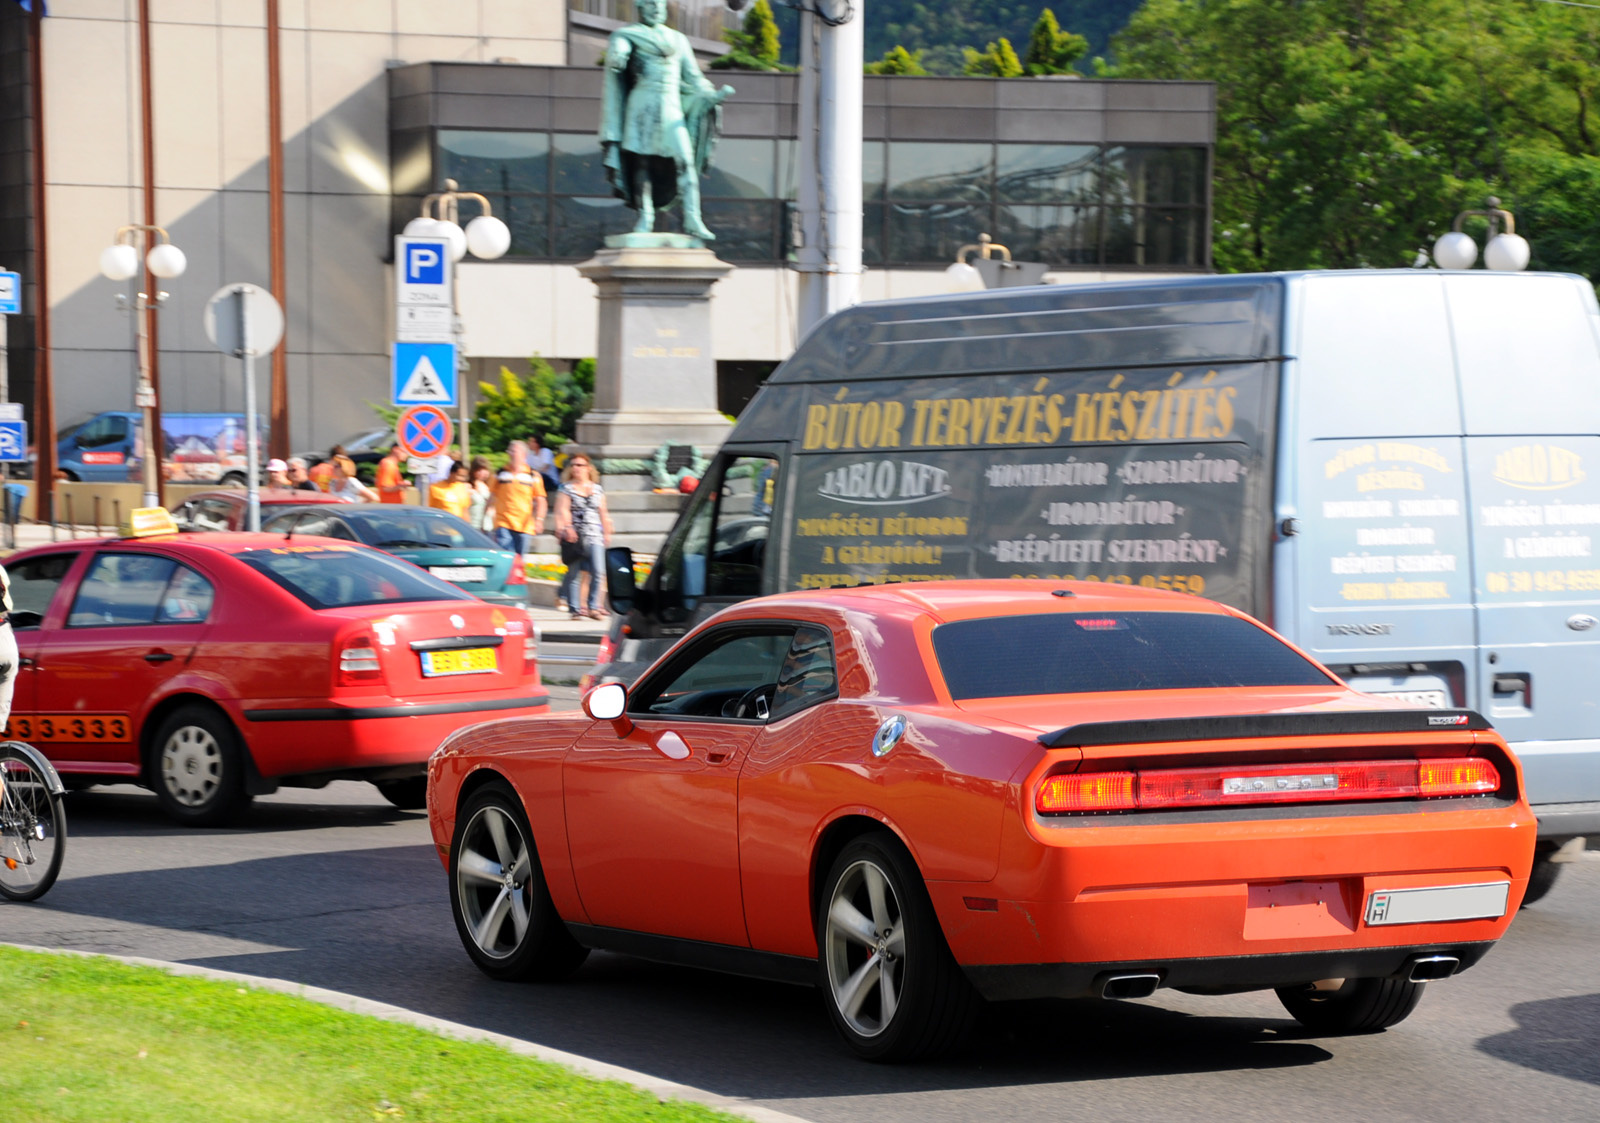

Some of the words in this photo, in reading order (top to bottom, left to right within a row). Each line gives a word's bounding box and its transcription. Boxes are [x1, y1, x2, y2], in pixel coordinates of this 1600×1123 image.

[410, 249, 439, 279] P
[802, 386, 905, 449] BÚTOR
[910, 370, 1238, 446] TERVEZÉS-KÉSZÍTÉS
[1047, 494, 1175, 526] IRODABÚTOR
[996, 532, 1104, 563] BEÉPÍTETT
[1107, 531, 1220, 563] SZEKRÉNY
[1372, 909, 1385, 921] H
